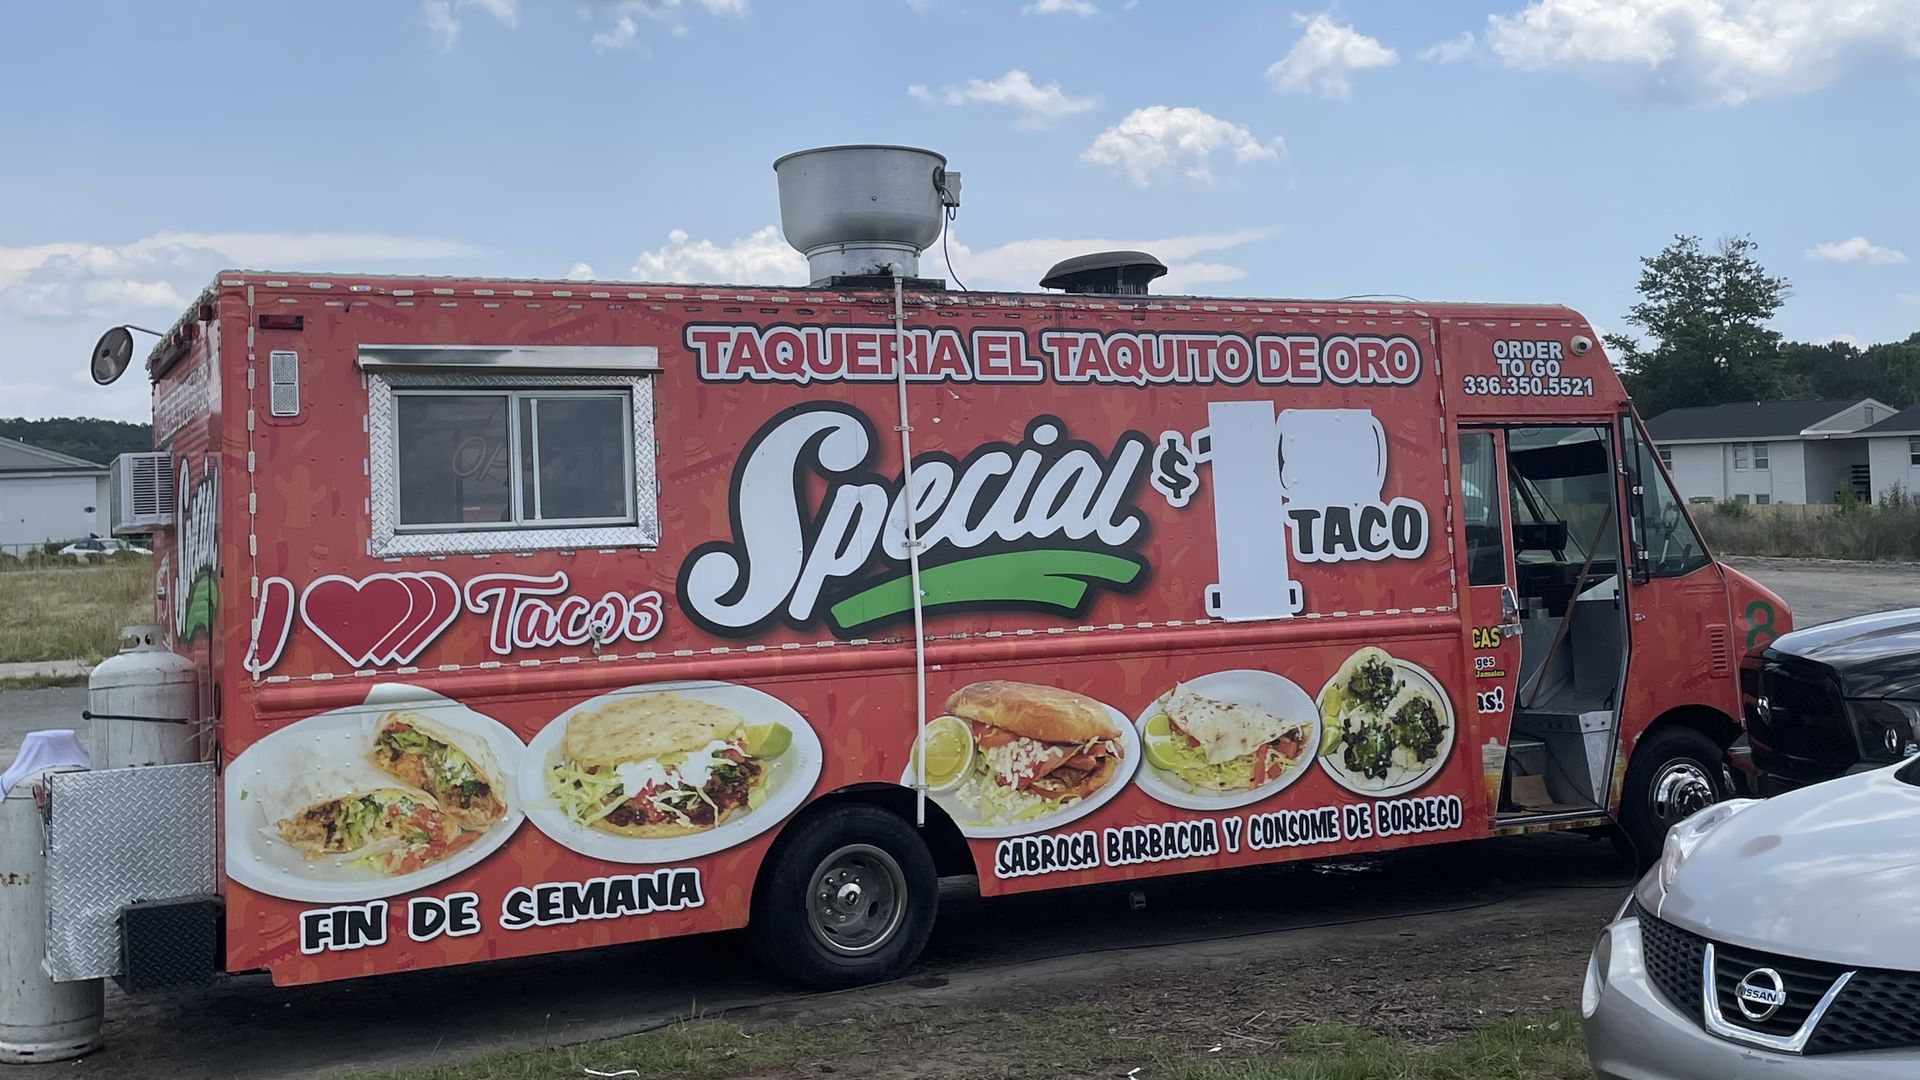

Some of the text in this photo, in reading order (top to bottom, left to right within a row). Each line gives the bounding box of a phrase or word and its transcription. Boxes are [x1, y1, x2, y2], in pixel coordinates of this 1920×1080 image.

[689, 329, 1419, 384] TAQUERIA EL TAQUITO DE ORO
[1492, 340, 1563, 360] ORDER
[1496, 359, 1560, 377] TO GO
[1463, 375, 1594, 396] 336.350.5521
[686, 410, 1141, 628] Special
[1286, 501, 1426, 559] TACO
[466, 571, 662, 654] Tacos
[1475, 670, 1505, 678] Jamaica
[997, 796, 1461, 876] SABROSA BARBACOA Y CONSOME DE BORREGO
[303, 870, 703, 951] FIN DE SEMANA
